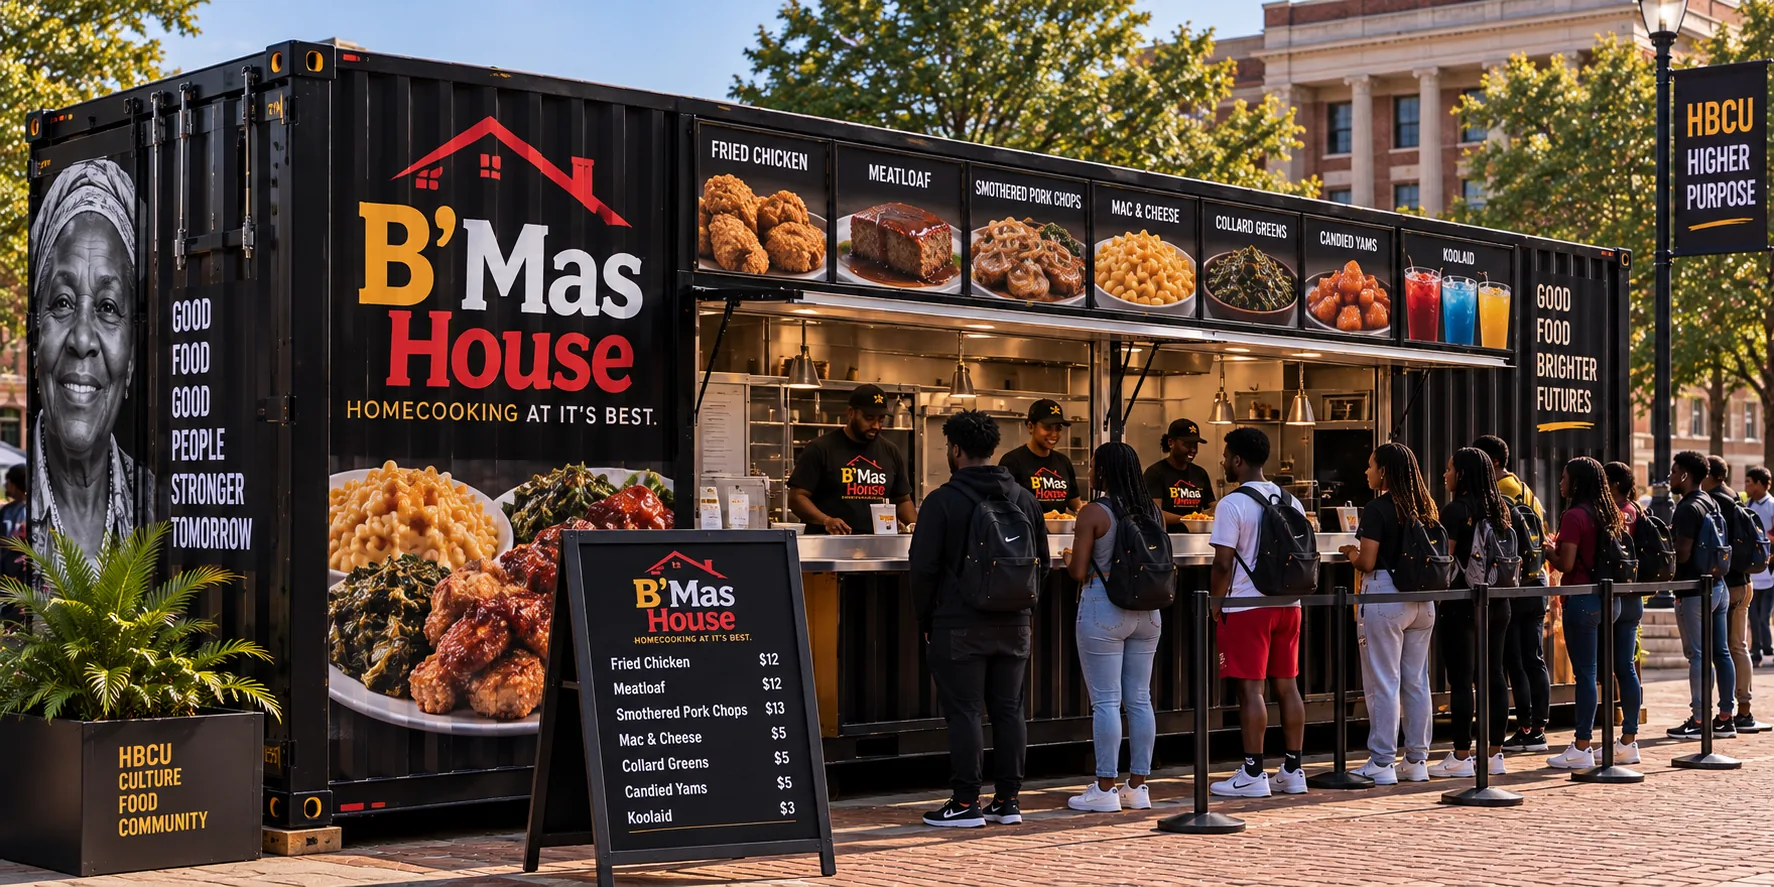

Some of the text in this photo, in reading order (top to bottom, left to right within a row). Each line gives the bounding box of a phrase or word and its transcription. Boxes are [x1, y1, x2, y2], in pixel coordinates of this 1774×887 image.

[1688, 97, 1753, 137] HBCU
[712, 140, 807, 170] FRIED CHICKEN
[1688, 144, 1749, 175] HIGHER
[869, 164, 931, 188] MEATLOAF
[976, 180, 1081, 209] SMOTHERED PORK CHOPS
[1687, 179, 1755, 210] PURPOSE
[1112, 200, 1179, 223] MAC & CHEESE
[1216, 215, 1286, 238] COLLARD GREENS
[1320, 231, 1377, 251] CANDIED YAMS
[358, 201, 642, 319] B'Mas
[1443, 248, 1474, 265] KOOLAID
[1537, 284, 1570, 311] GOOD
[173, 298, 211, 332] GOOD
[1537, 318, 1570, 345] FOOD
[173, 342, 209, 375] FOOD
[386, 309, 635, 393] House
[1537, 353, 1597, 381] BRIGHTER
[172, 386, 210, 418] GOOD
[1537, 387, 1591, 413] FUTURES
[346, 400, 656, 425] HOMECOOKING AT IT'S BEST.
[172, 428, 225, 461] PEOPLE
[841, 467, 886, 484] B'Mas
[1030, 476, 1067, 489] B'Mas
[171, 473, 244, 504] STRONGER
[171, 517, 252, 550] TOMORROW
[633, 577, 736, 608] B'Mas
[647, 608, 736, 632] House
[634, 636, 697, 645] HOMECOOKING
[699, 634, 709, 642] AT
[729, 634, 752, 642] BEST.
[611, 656, 690, 670] Fried Chicken
[760, 653, 779, 666] $12
[614, 681, 665, 695] Meatloaf
[763, 677, 782, 690] $12
[617, 704, 747, 721] Smothered Pork Chops
[766, 702, 784, 715] $13
[619, 732, 702, 746] Mac & Cheese
[772, 727, 786, 740] $5
[119, 743, 172, 768] HBCU
[623, 757, 709, 772] Collard Greens
[775, 751, 789, 765] $5
[119, 768, 181, 791] CULTURE
[625, 783, 707, 798] Candied Yams
[777, 776, 792, 790] $5
[119, 793, 157, 814] FOOD
[780, 801, 795, 815] $3
[119, 811, 207, 837] COMMUNITY
[628, 809, 672, 824] Koolaid
